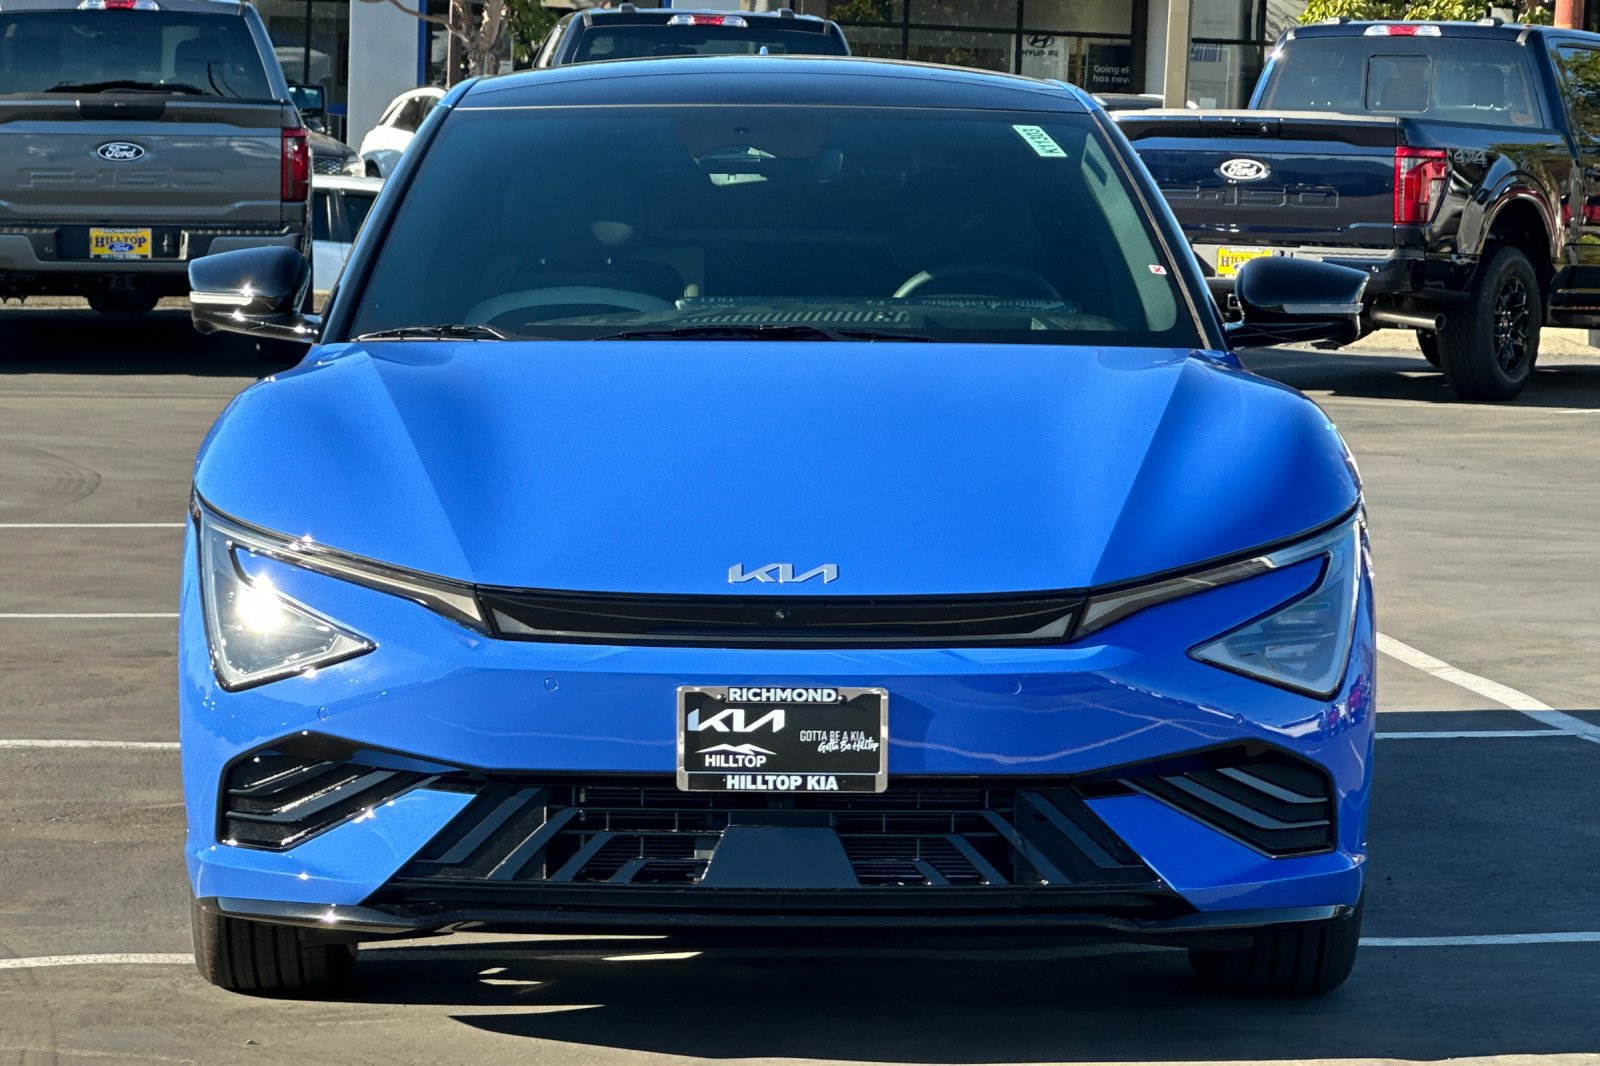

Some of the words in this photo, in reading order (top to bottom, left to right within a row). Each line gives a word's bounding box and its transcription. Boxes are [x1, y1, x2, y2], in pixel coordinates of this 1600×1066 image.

[1093, 64, 1120, 75] Going
[1093, 74, 1110, 83] has
[105, 143, 136, 158] Ford
[1228, 161, 1258, 176] Ford
[94, 234, 147, 247] HILLTOP
[728, 563, 839, 583] KIA
[729, 688, 837, 702] RICHMOND
[687, 708, 785, 733] KIA
[800, 730, 828, 741] GOTTA
[830, 731, 840, 741] BE
[842, 731, 849, 741] A
[850, 731, 866, 741] KIA
[817, 740, 840, 753] Gotta
[840, 739, 852, 752] Be
[852, 736, 879, 752] Hilltop
[704, 754, 767, 768] HILLTOP
[726, 775, 803, 790] HILLTOP
[806, 775, 839, 790] KIA
